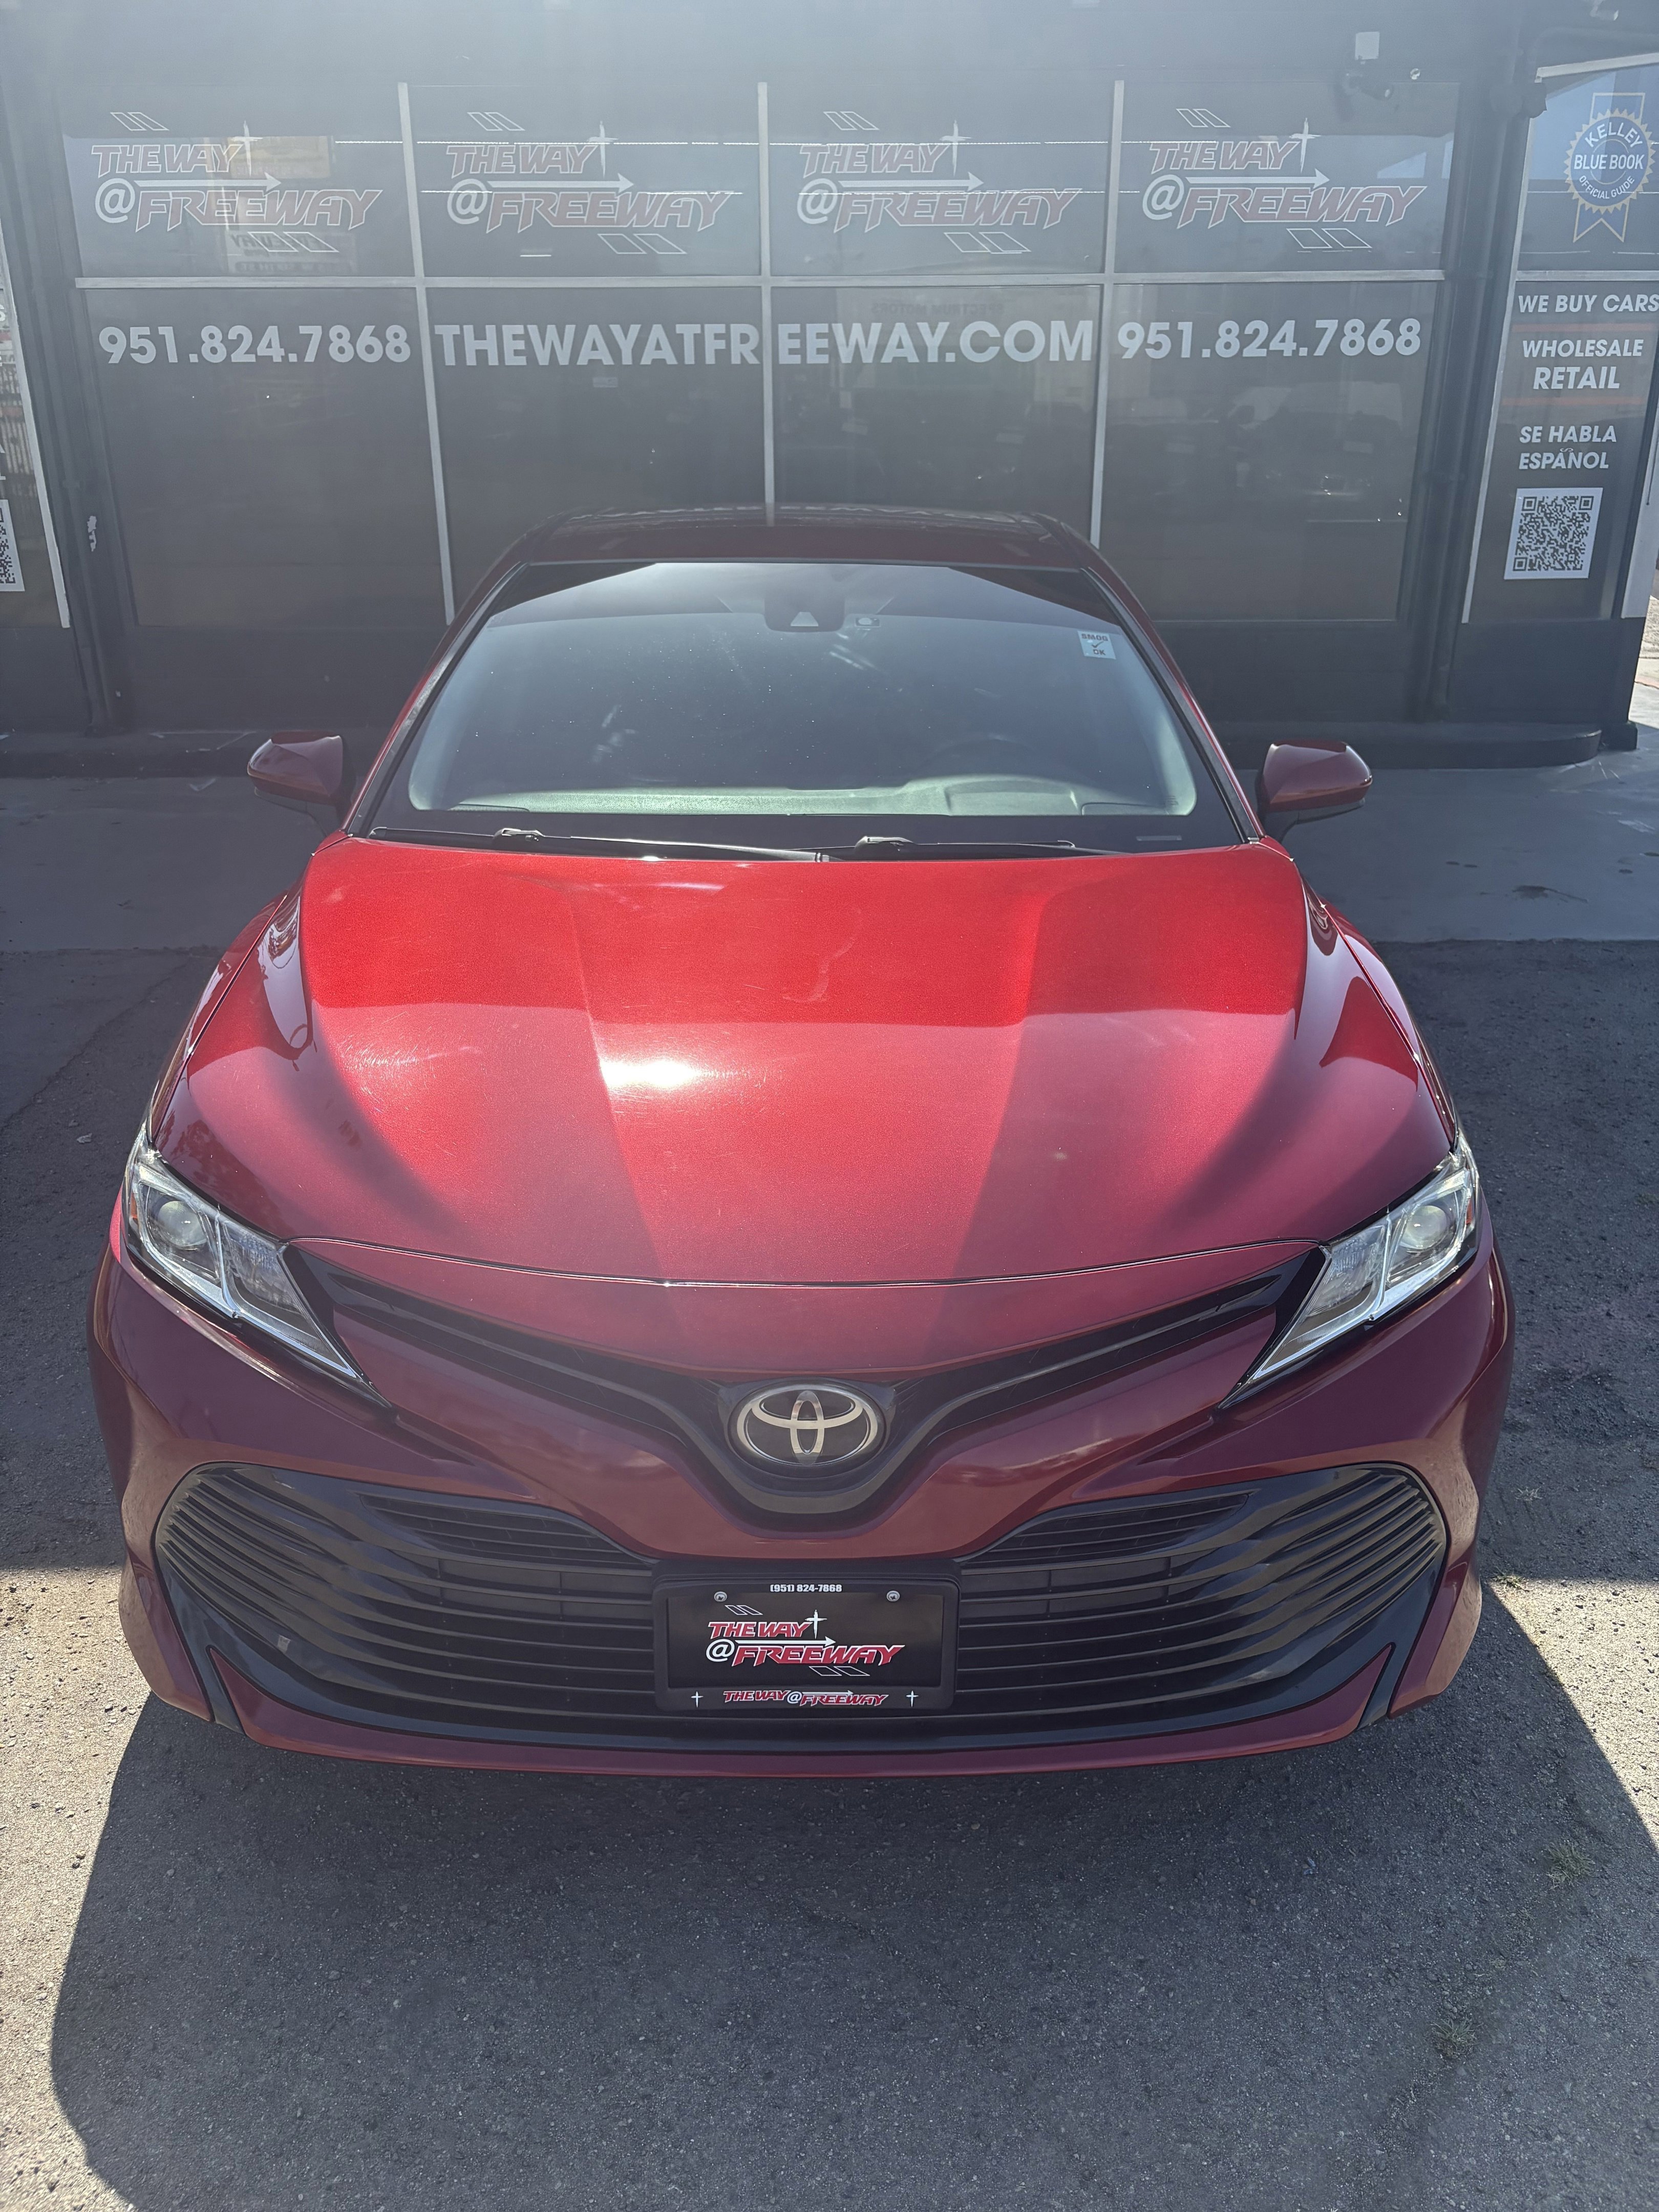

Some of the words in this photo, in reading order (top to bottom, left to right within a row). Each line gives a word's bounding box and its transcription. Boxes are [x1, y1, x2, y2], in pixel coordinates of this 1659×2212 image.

[1584, 121, 1643, 148] KELLEY
[1573, 154, 1607, 170] BLUE
[1609, 154, 1645, 170] BOOK
[1579, 175, 1610, 199] OFFICIAL
[1611, 175, 1635, 198] GUIDE
[1518, 295, 1549, 313] WE
[1555, 294, 1598, 312] BUY
[1603, 294, 1659, 312] CARS
[98, 325, 411, 365] 951.824.7868
[1117, 317, 1421, 359] 951.824.7868
[1522, 339, 1644, 358] WHOLESALE
[1533, 366, 1620, 390] RETAIL
[1519, 426, 1542, 443] SE
[1548, 425, 1617, 443] HABLA
[1519, 447, 1609, 470] ESPAÑOL
[770, 1584, 795, 1592] (951)
[796, 1584, 842, 1592] 824-7868
